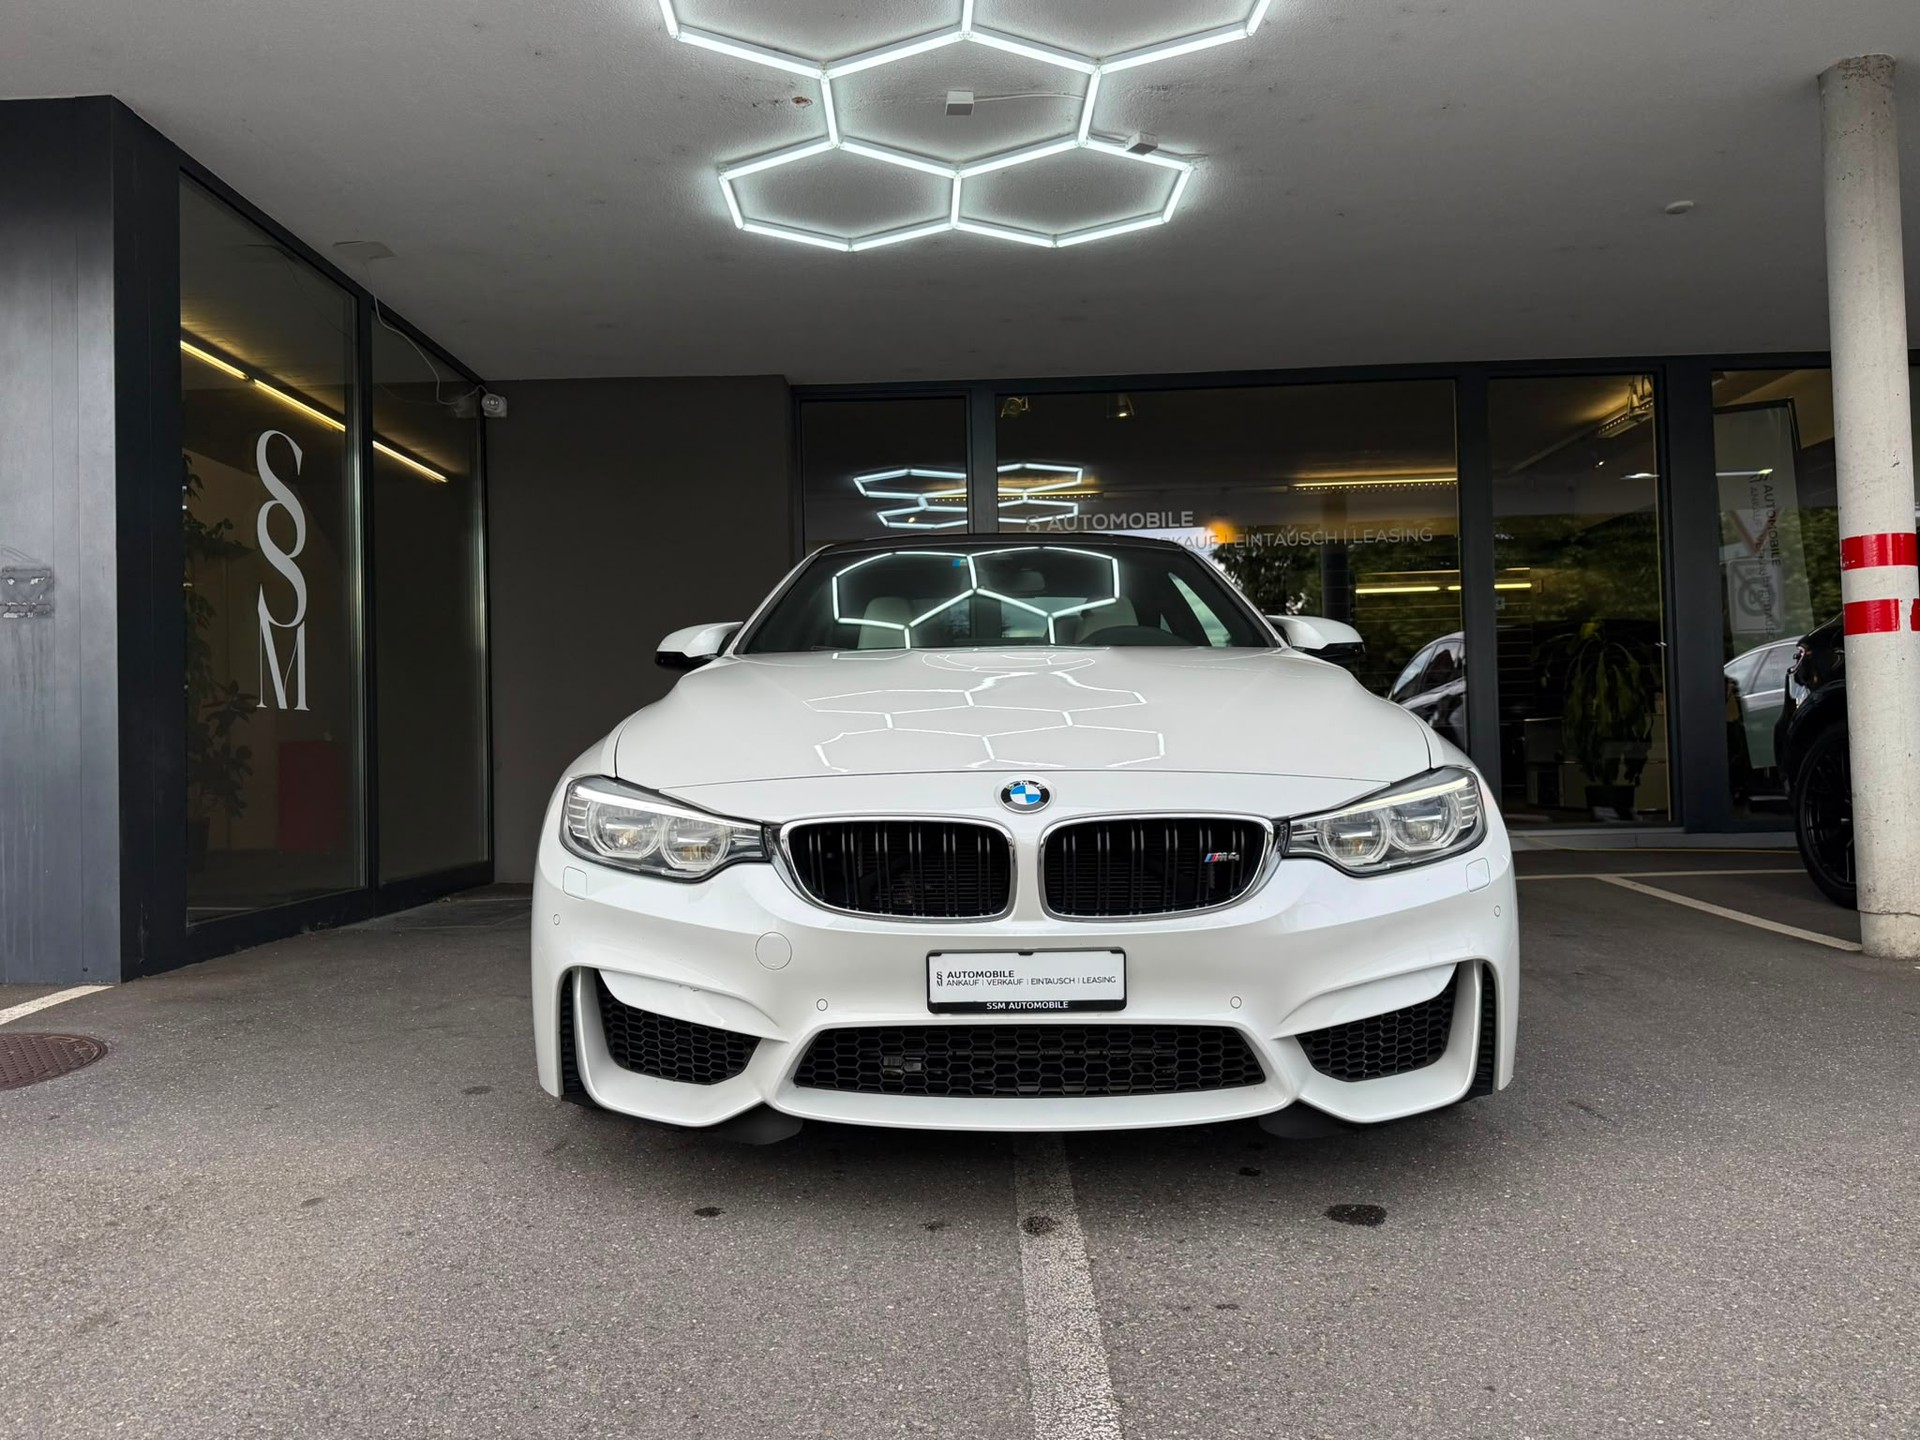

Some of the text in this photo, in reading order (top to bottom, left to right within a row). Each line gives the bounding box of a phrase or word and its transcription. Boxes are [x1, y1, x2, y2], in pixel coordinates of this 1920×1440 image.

[1046, 510, 1194, 532] AUTOMOBILE
[1763, 484, 1781, 566] AUTOMOBILE
[1233, 530, 1338, 549] EINTAUSCH
[1352, 527, 1433, 545] LEASING
[946, 970, 1015, 979] AUTOMOBILE
[946, 975, 1117, 987] ANKAUF VERKAUF EINTAUSCH LEASING
[986, 1000, 1069, 1010] SSM AUTOMOBILE
